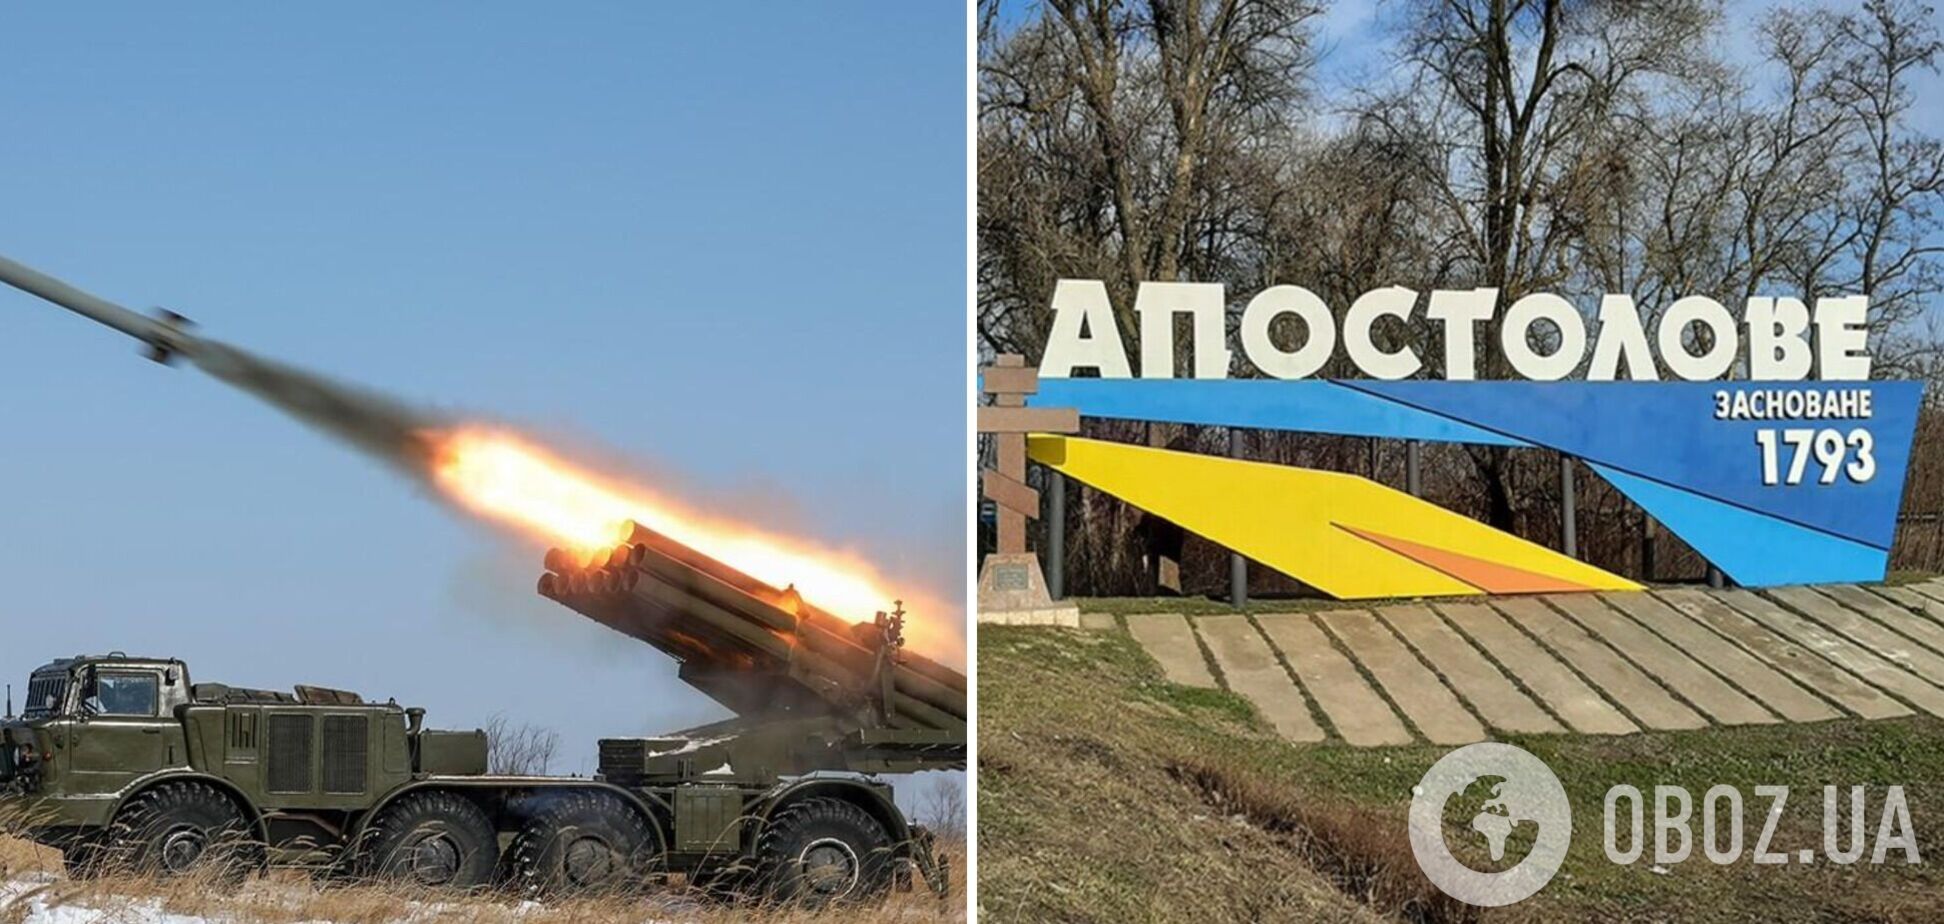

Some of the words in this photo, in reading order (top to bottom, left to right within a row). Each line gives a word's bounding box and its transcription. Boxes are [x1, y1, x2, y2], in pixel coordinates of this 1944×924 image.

[1037, 279, 1873, 380] АПОСТОЛОВЕ
[1714, 389, 1873, 420] ЗАСНОВАНЕ
[1756, 428, 1877, 485] 1793
